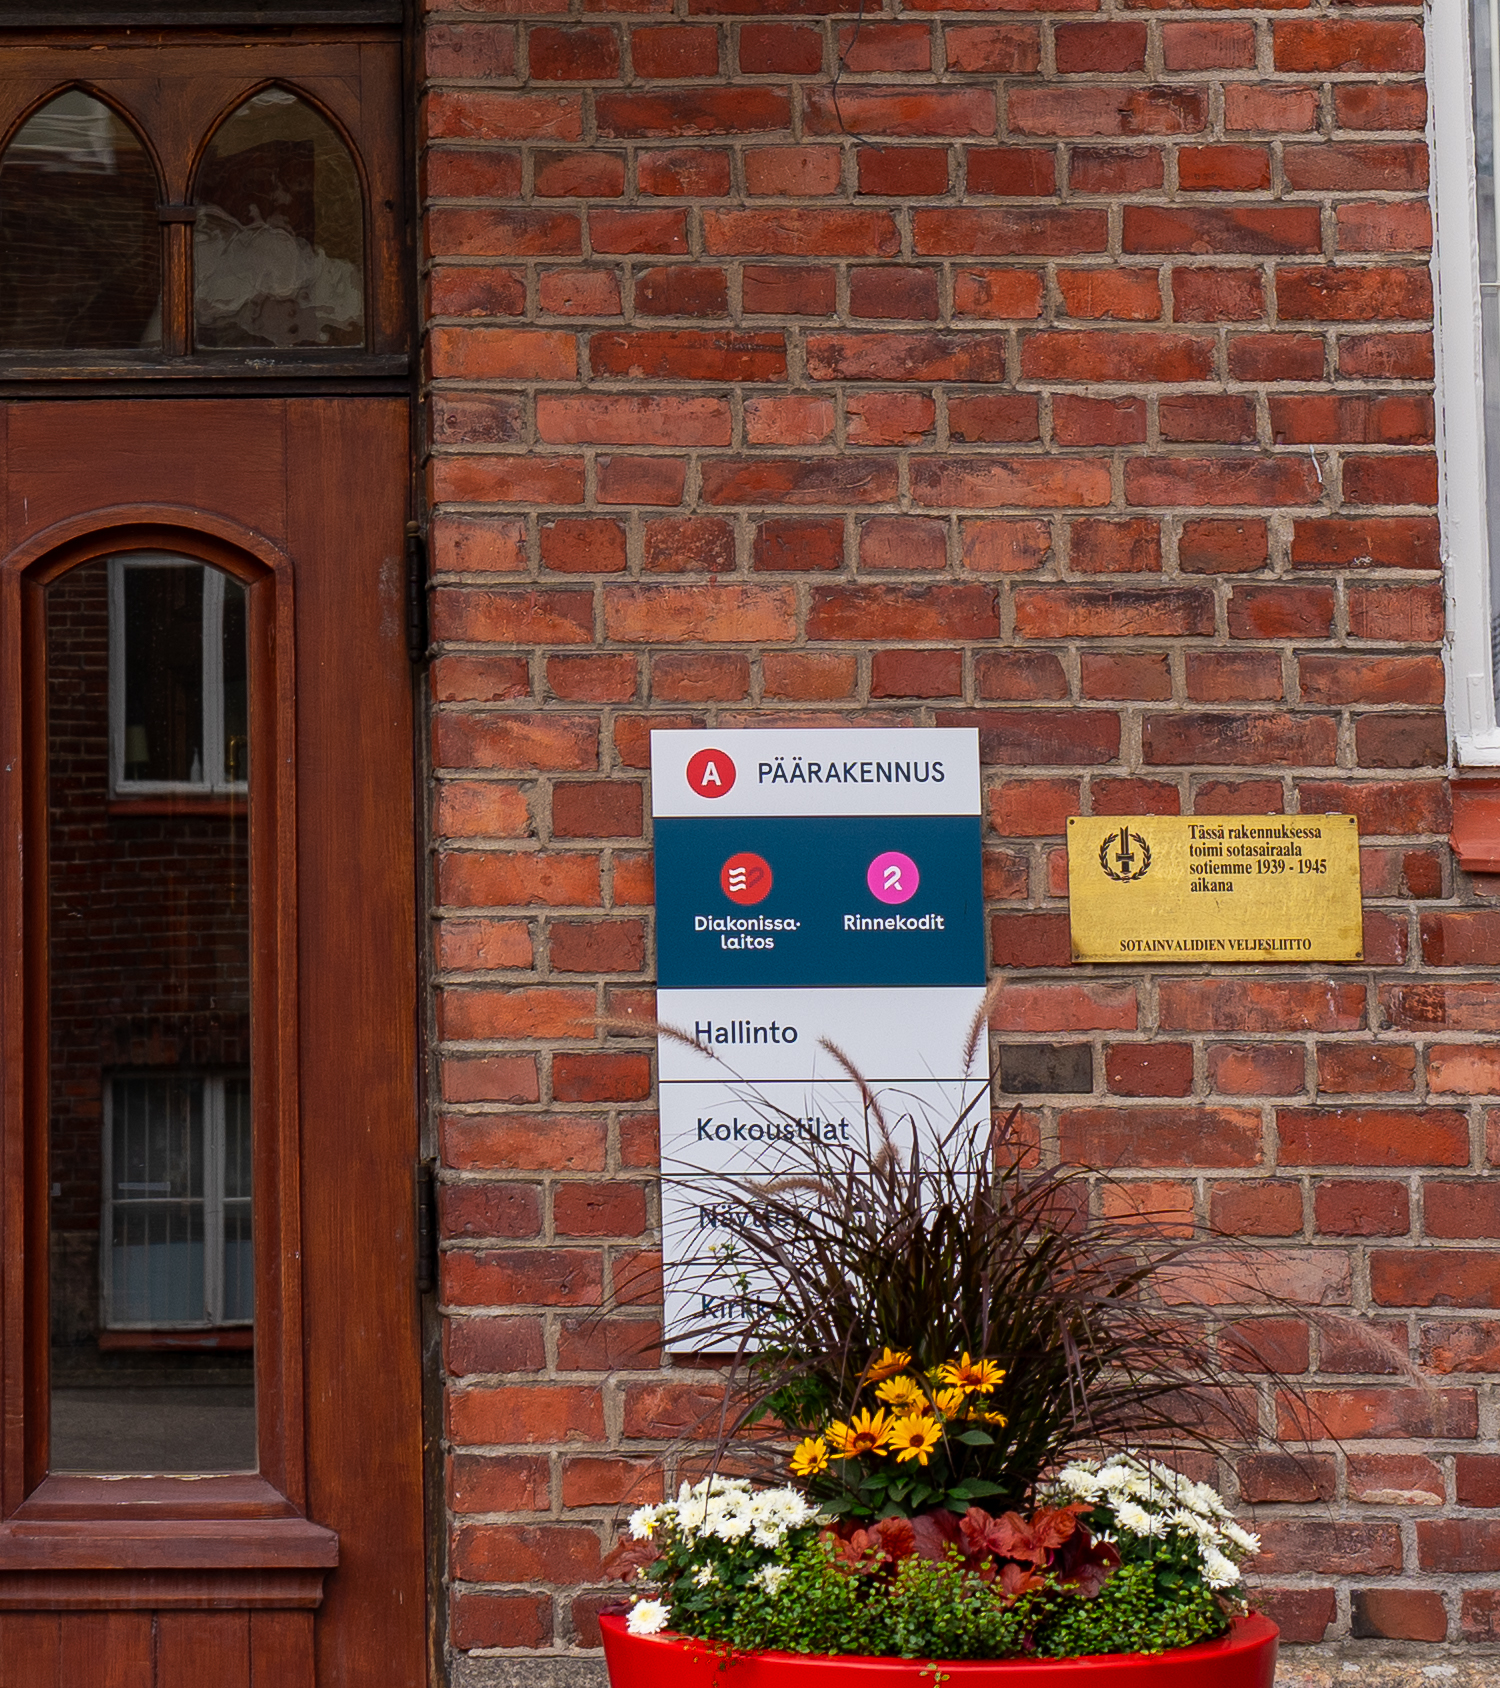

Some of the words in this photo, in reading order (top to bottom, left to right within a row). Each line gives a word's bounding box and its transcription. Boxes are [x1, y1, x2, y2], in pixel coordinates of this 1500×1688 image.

[701, 761, 722, 786] A
[757, 756, 945, 784] PÄÄRAKENNUS
[1188, 824, 1225, 840] Tässä
[1228, 824, 1322, 840] rakennuksessa
[1189, 842, 1223, 857] toimi
[1226, 842, 1302, 857] sotasairaala
[1189, 860, 1252, 875] sotiemme
[1256, 859, 1286, 874] 1939
[1297, 859, 1327, 874] 1945
[1190, 878, 1234, 892] aikana
[843, 914, 945, 930] Rinnekodit
[720, 934, 775, 950] laitos
[1120, 939, 1226, 951] SOTAINVALIDIEN
[1228, 938, 1312, 951] VELJESLIITTO
[694, 1020, 798, 1044] Hallinto
[697, 1118, 850, 1141] Kokoustilat
